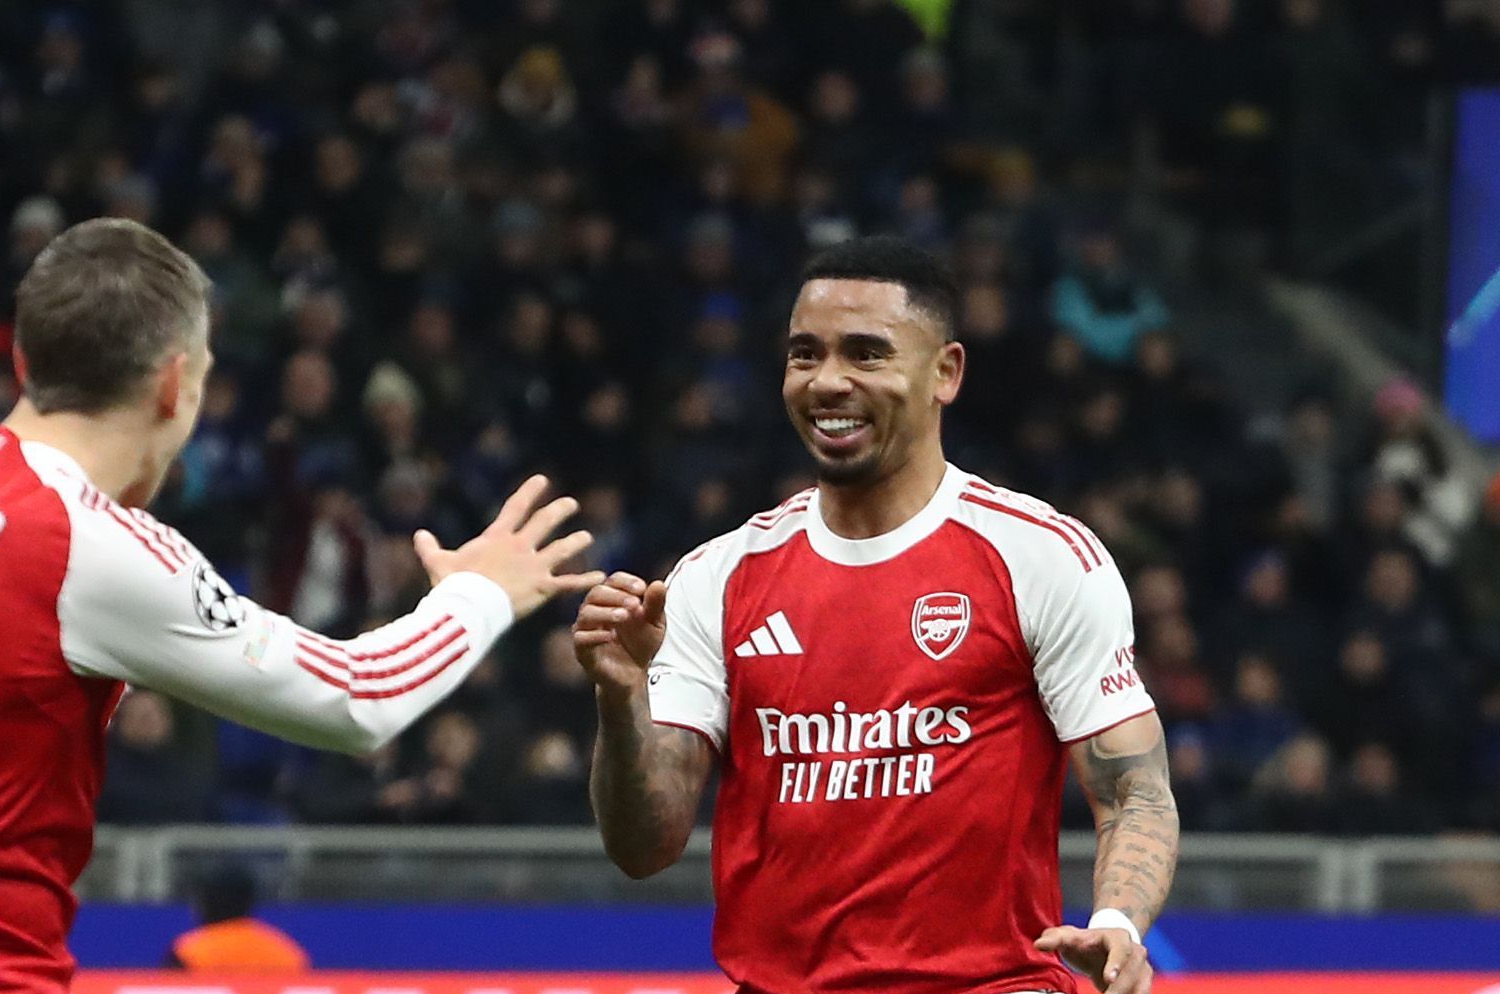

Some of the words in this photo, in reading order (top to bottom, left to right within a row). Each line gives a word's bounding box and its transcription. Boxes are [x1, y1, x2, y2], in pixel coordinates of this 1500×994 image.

[921, 604, 962, 615] Arsenal
[755, 700, 972, 757] Emirates
[779, 762, 821, 803] FLY
[825, 753, 935, 801] BETTER
